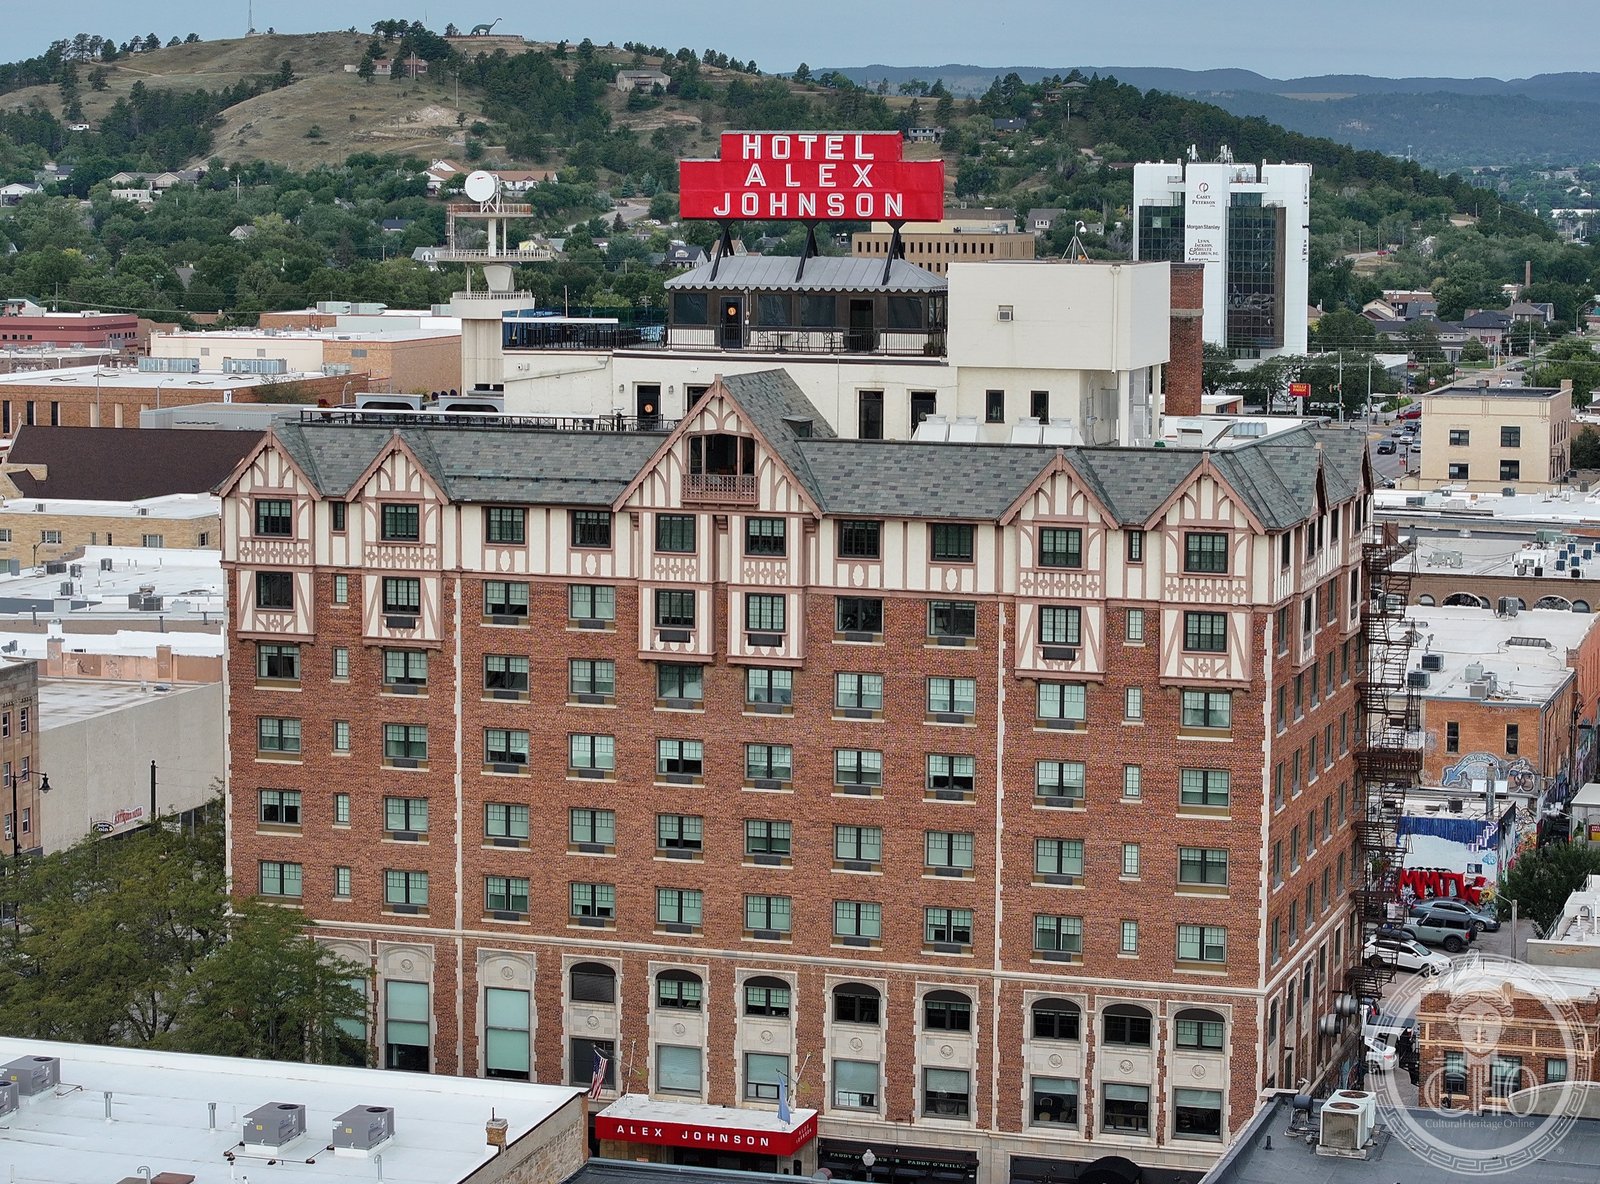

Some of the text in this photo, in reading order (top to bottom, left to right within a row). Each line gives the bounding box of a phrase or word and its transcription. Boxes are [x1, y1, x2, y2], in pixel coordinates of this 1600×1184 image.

[742, 134, 875, 160] HOTEL
[744, 163, 873, 188] ALEX
[713, 192, 903, 217] JOHNSON
[616, 1124, 770, 1147] ALEX JOHNSON
